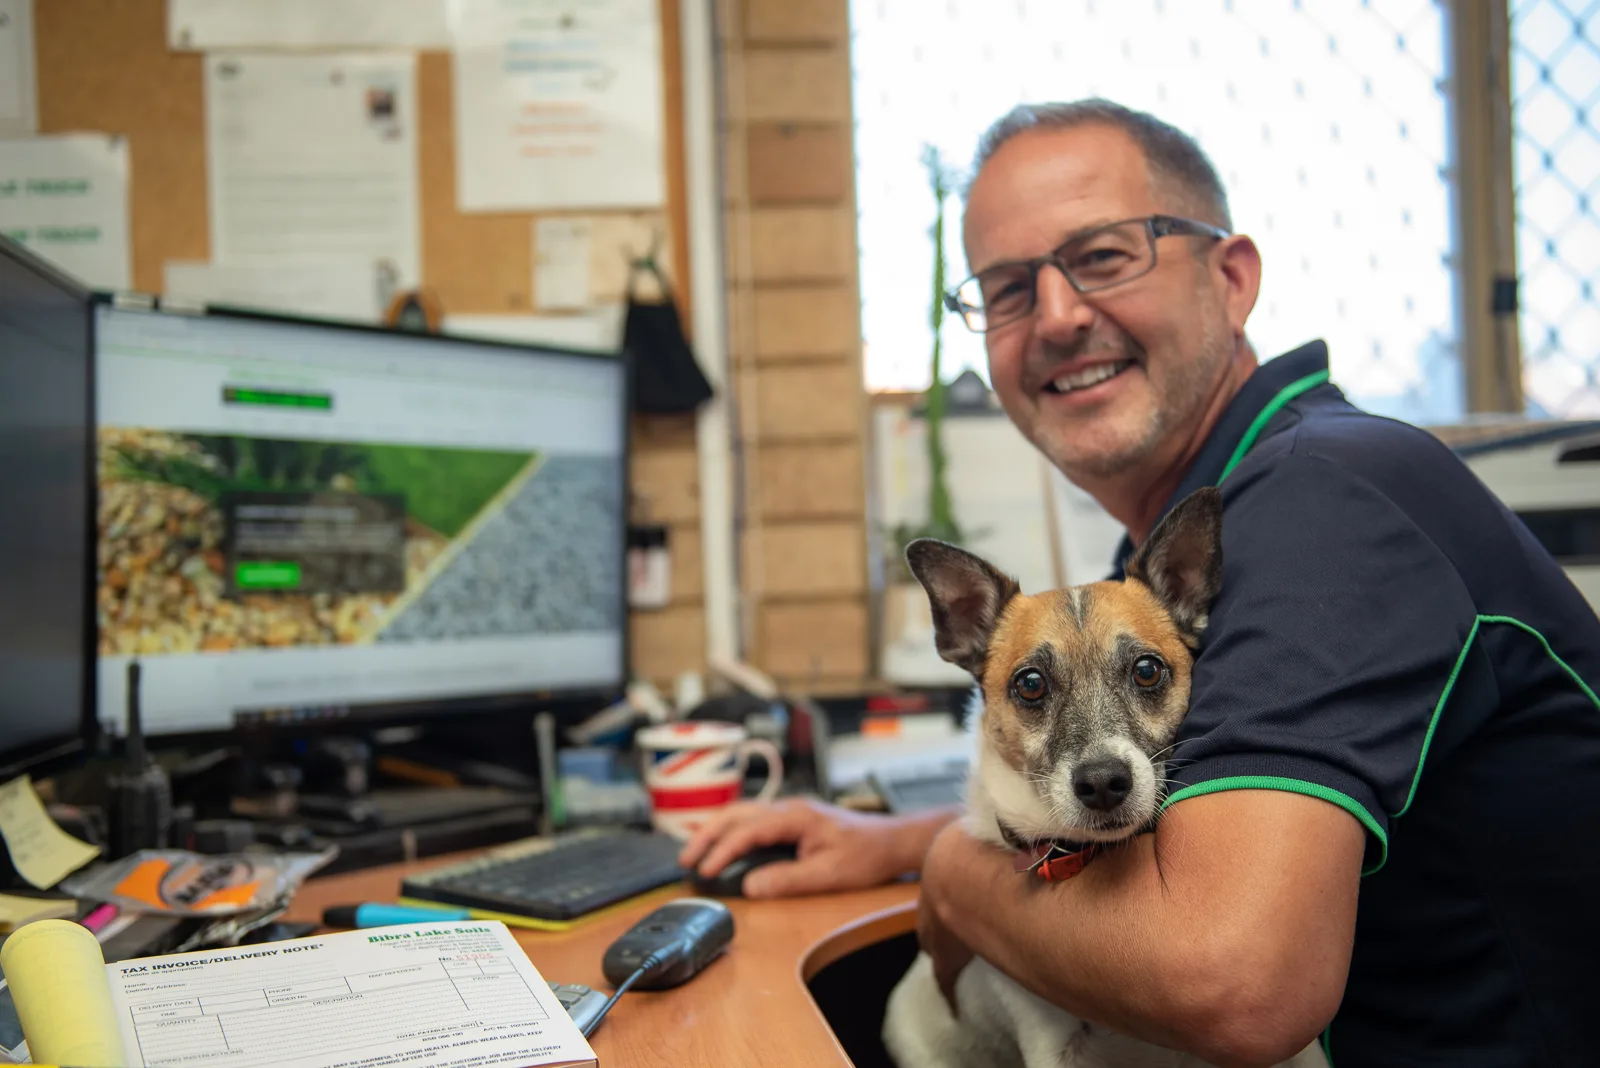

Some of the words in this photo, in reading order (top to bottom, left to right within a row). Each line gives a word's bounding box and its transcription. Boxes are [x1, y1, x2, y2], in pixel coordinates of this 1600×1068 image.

[368, 933, 411, 943] Bibra
[414, 929, 452, 938] Lake
[120, 965, 148, 974] TAX
[152, 949, 279, 970] INVOICE/DELIVERY
[138, 1002, 172, 1011] DELIVERY
[156, 1018, 197, 1027] QUANTITY
[417, 1027, 446, 1035] PAYABLE
[360, 1054, 392, 1064] HARMFUL
[452, 1039, 479, 1047] ALWAYS
[450, 1056, 487, 1065] CUSTOMER
[531, 1045, 562, 1053] DELIVERY
[376, 1058, 400, 1066] HANDS
